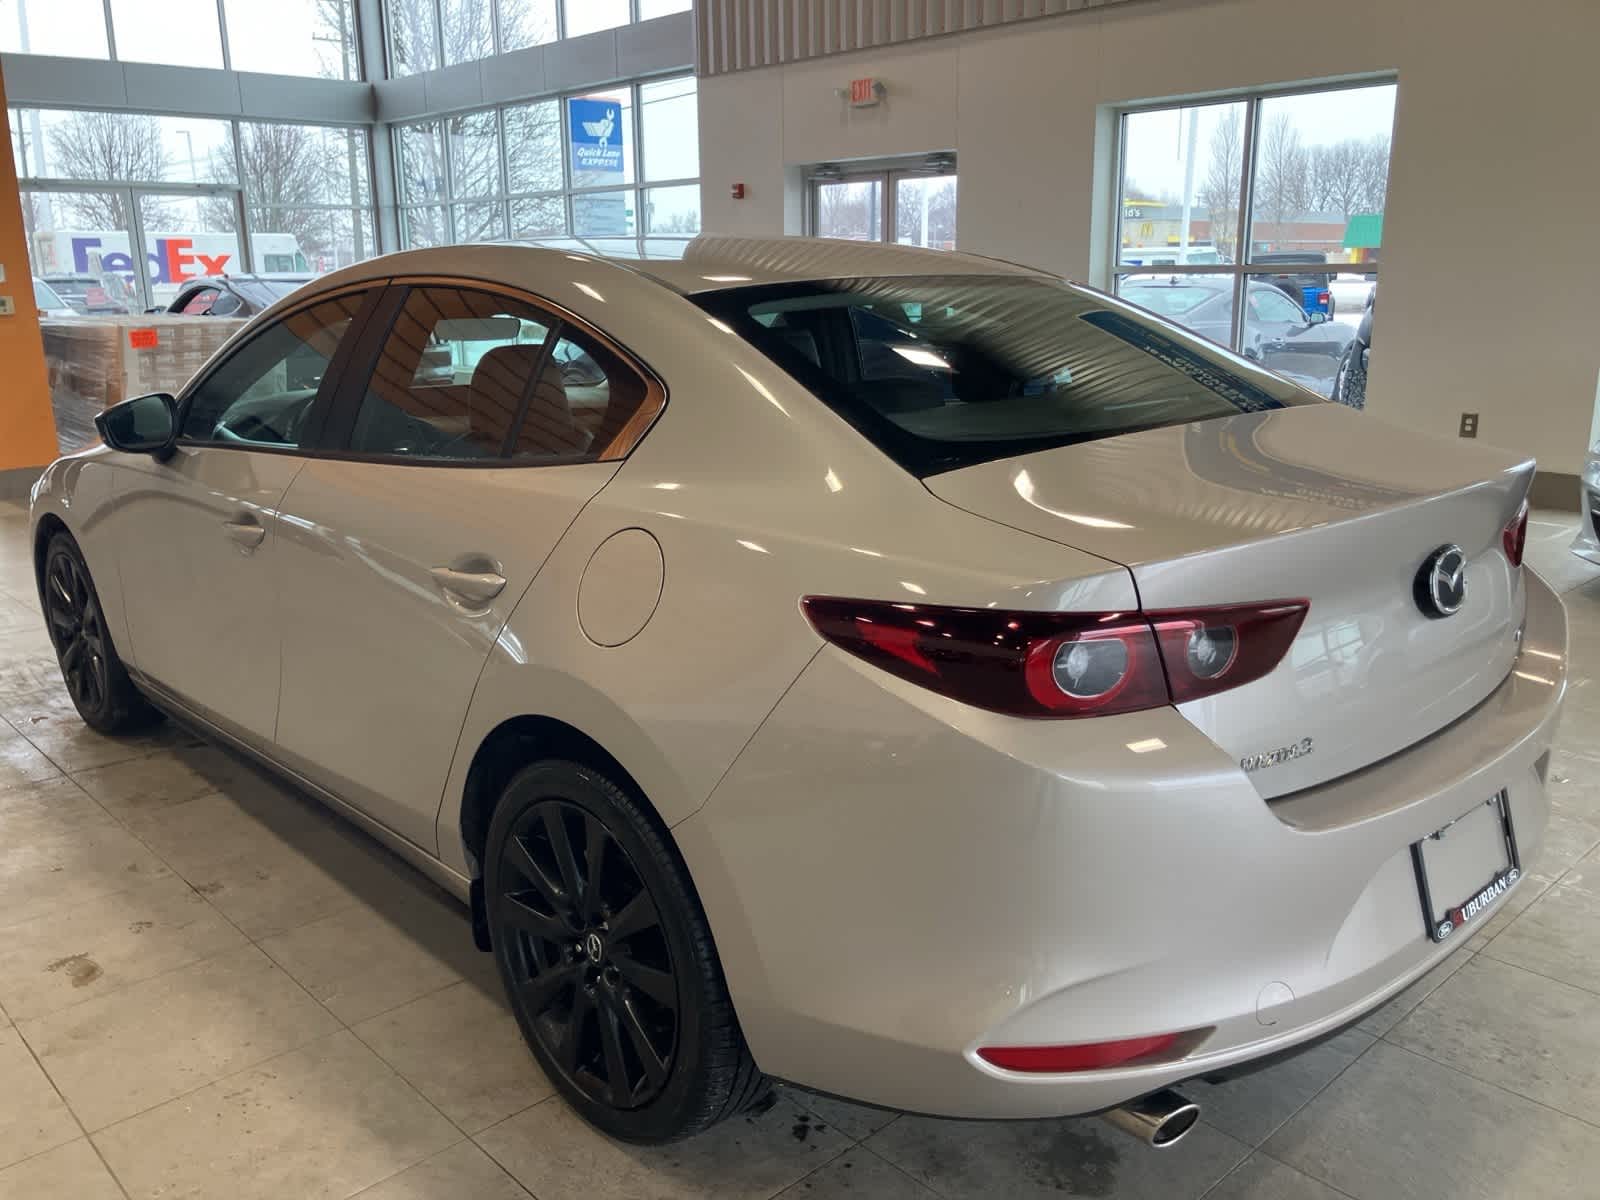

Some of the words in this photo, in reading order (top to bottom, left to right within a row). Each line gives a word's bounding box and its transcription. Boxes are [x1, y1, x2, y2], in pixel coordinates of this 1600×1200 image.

[851, 78, 872, 103] EXIT
[577, 147, 603, 158] Quick
[72, 238, 232, 285] FedEx
